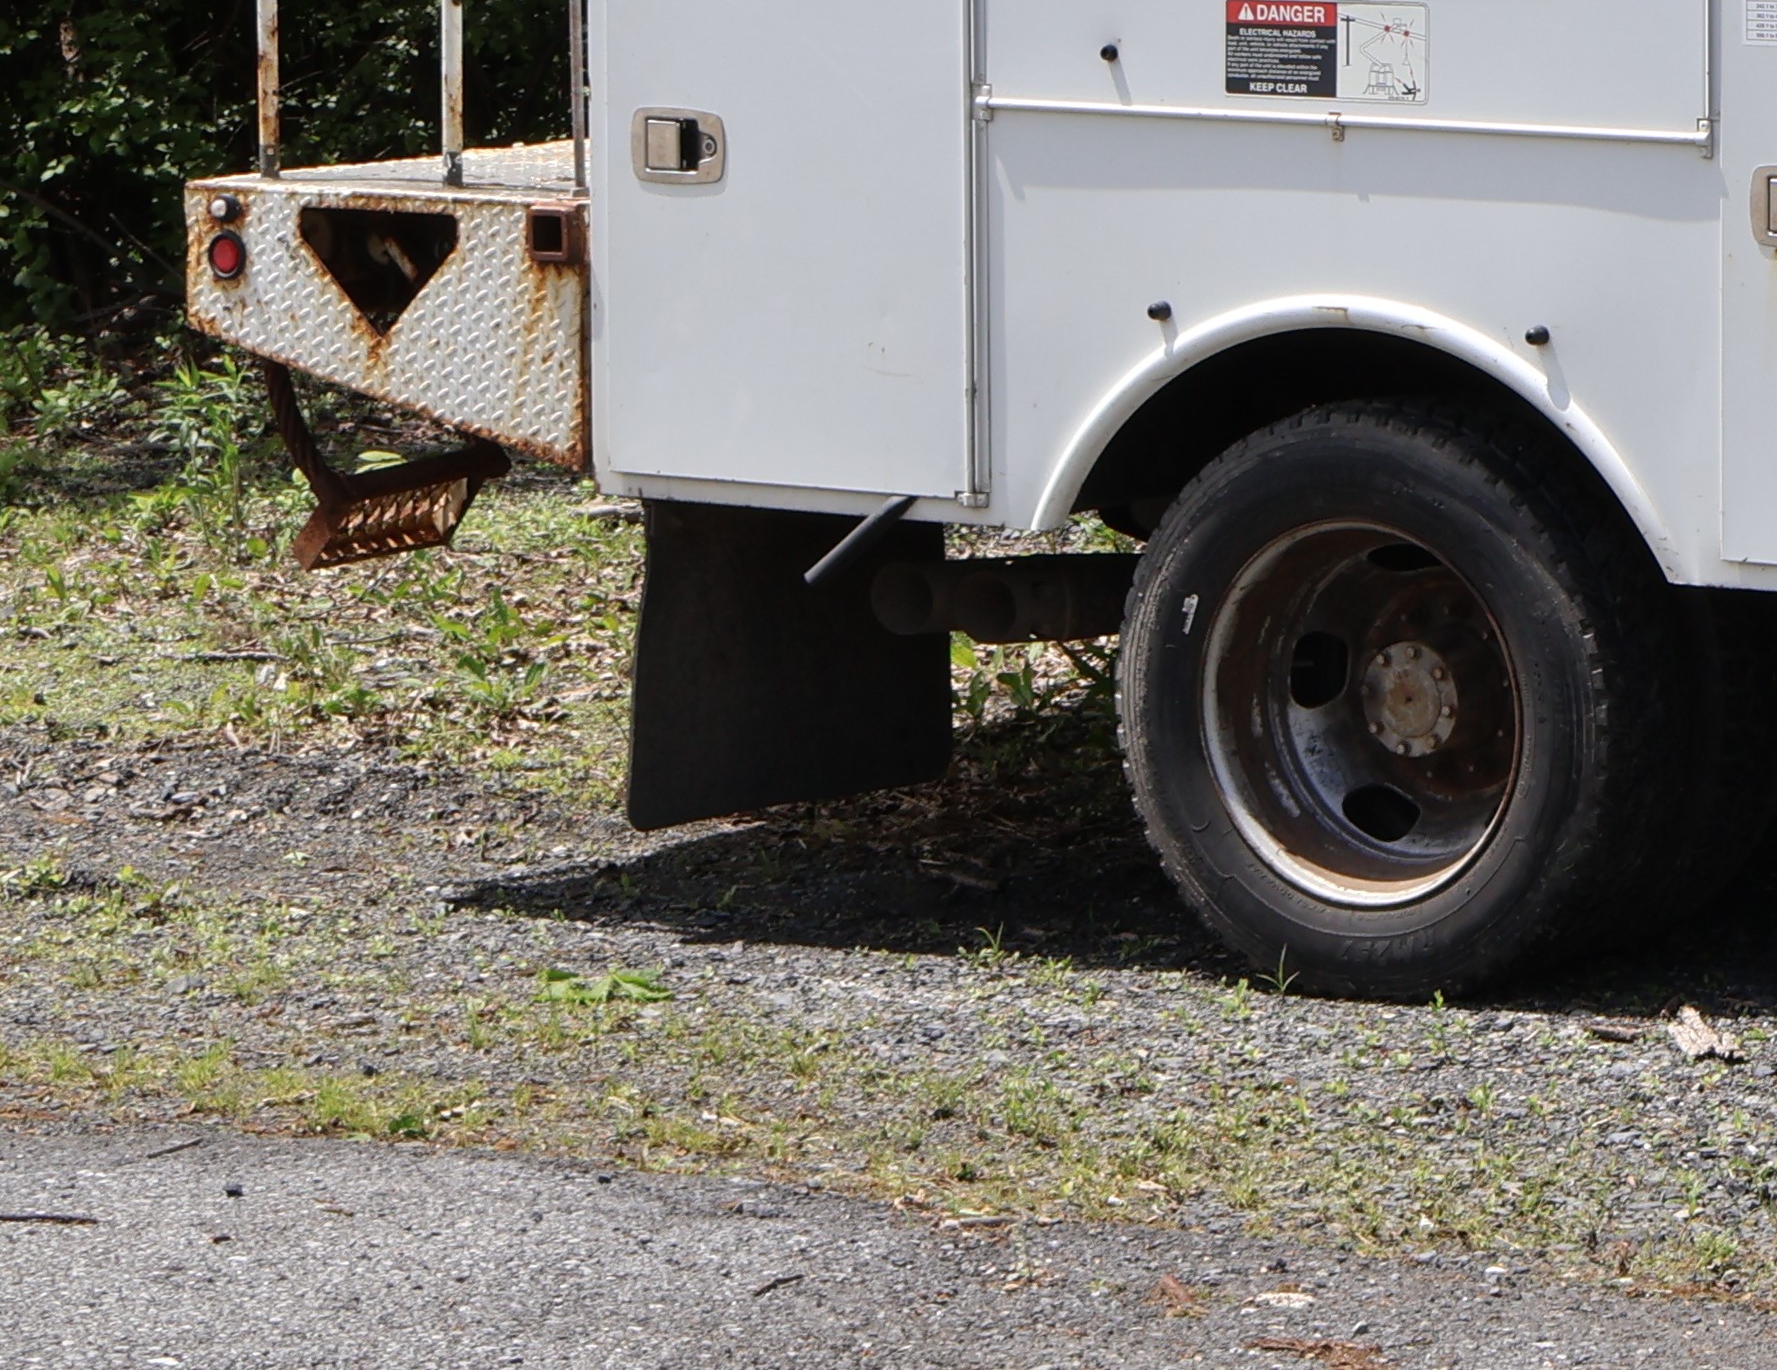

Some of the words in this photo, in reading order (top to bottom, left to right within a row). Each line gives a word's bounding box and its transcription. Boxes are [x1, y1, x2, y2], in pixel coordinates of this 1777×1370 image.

[1257, 4, 1325, 23] DANGER
[1239, 28, 1281, 36] ELECTRICAL
[1283, 29, 1316, 38] HAZARDS
[1249, 82, 1275, 92] KEEP
[1276, 83, 1307, 93] CLEAR
